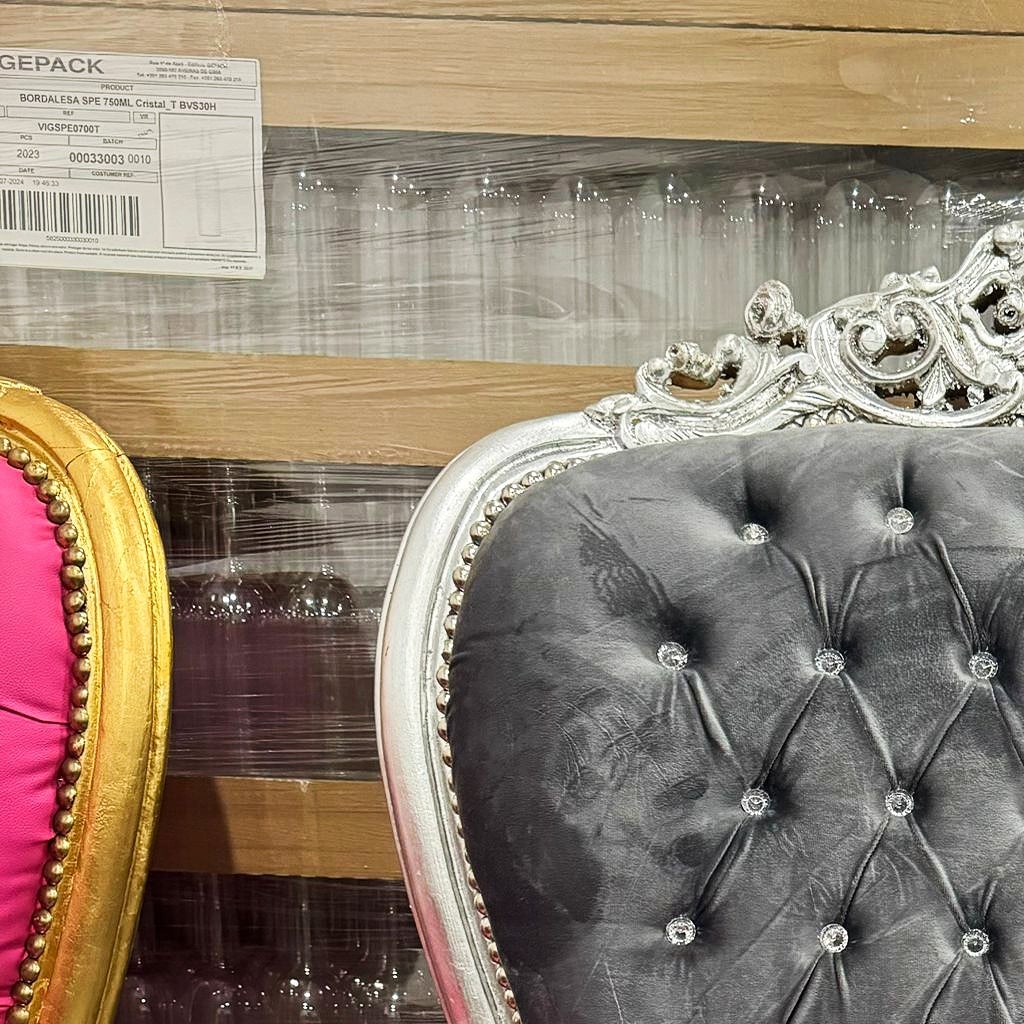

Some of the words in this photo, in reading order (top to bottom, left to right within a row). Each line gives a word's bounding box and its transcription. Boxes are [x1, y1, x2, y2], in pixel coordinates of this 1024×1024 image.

[0, 54, 105, 74] GEPACK
[20, 93, 80, 105] BORDALESA
[82, 96, 101, 106] SPE
[103, 97, 134, 107] 750ML
[179, 101, 217, 111] BVS30H
[37, 122, 100, 133] VIGSPE0700T
[16, 149, 40, 159] 2023
[69, 152, 125, 165] 00033003
[127, 154, 152, 165] 0010
